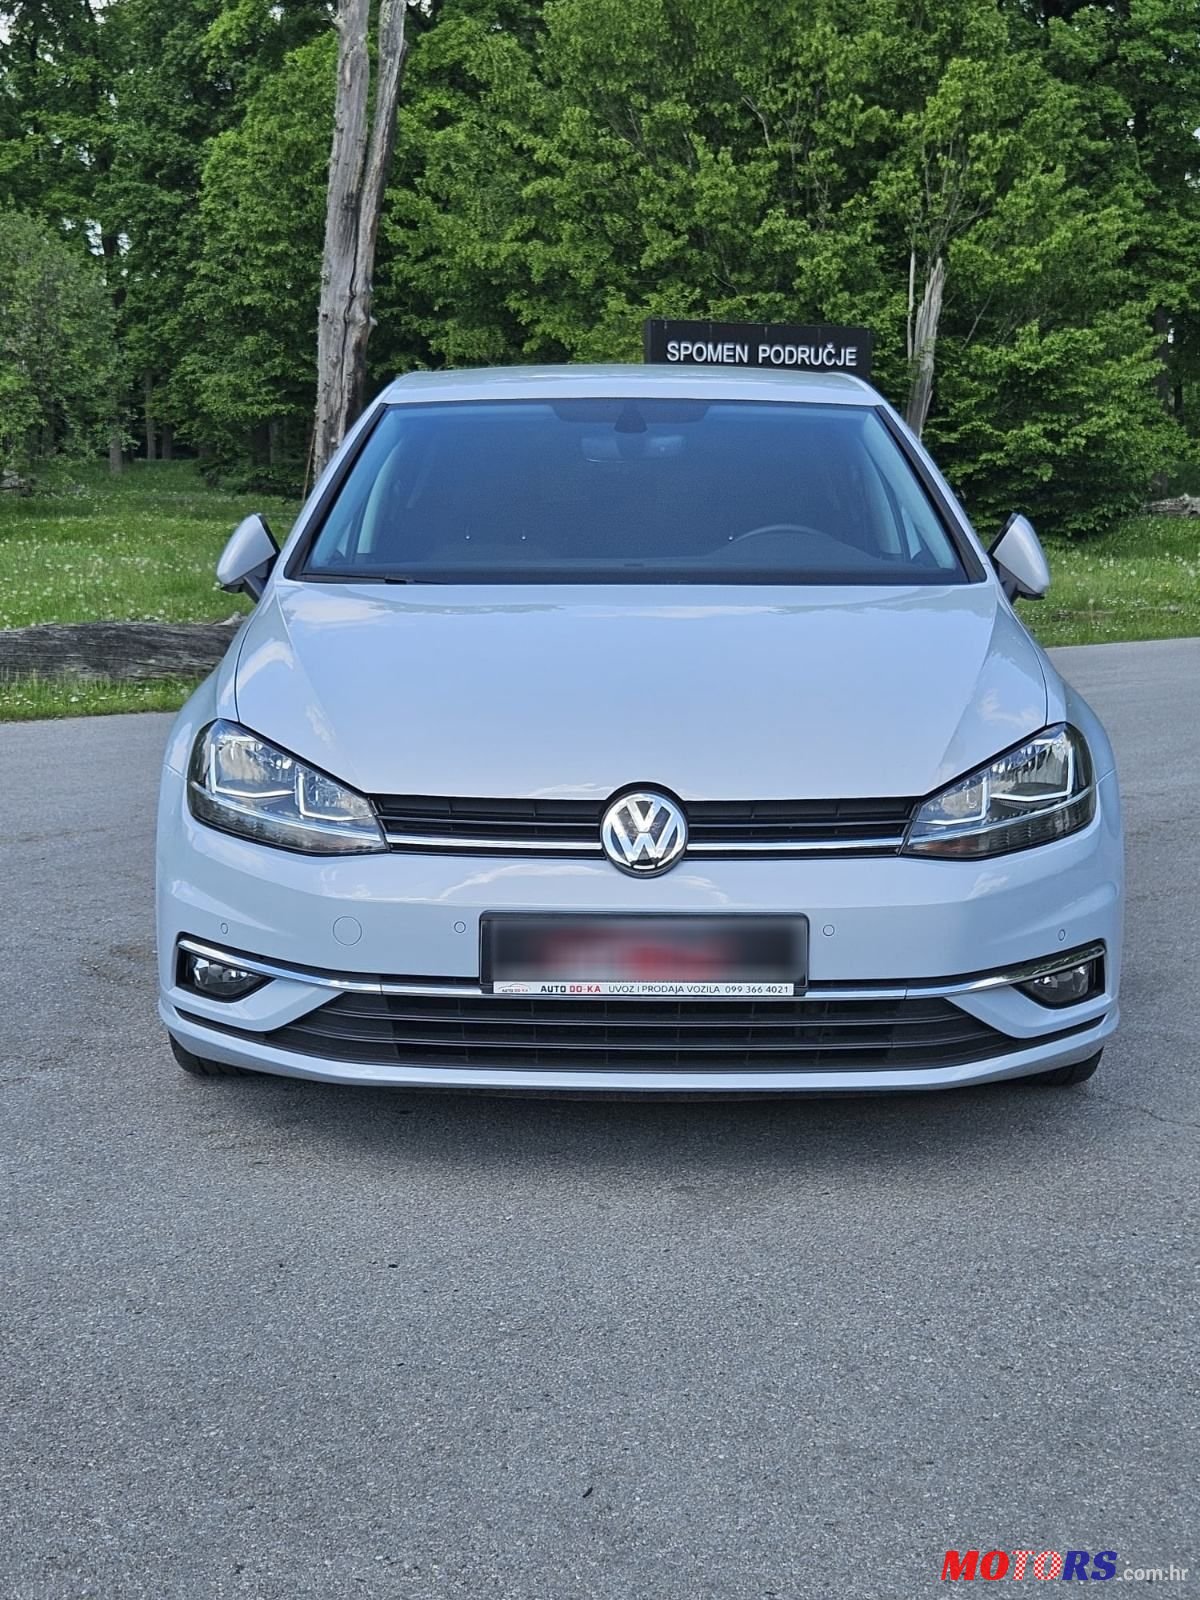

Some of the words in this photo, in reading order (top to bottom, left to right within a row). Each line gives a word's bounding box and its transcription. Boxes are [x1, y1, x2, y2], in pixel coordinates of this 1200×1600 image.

[666, 341, 749, 363] SPOMEN
[757, 343, 857, 366] PODRUČJE
[603, 793, 685, 870] VW
[540, 985, 567, 993] AUTO
[608, 985, 635, 993] UVOZ
[642, 985, 684, 995] PRODAJA
[686, 986, 720, 994] VOZILA
[725, 986, 743, 994] 099
[745, 986, 763, 994] 366
[766, 986, 788, 994] 4021
